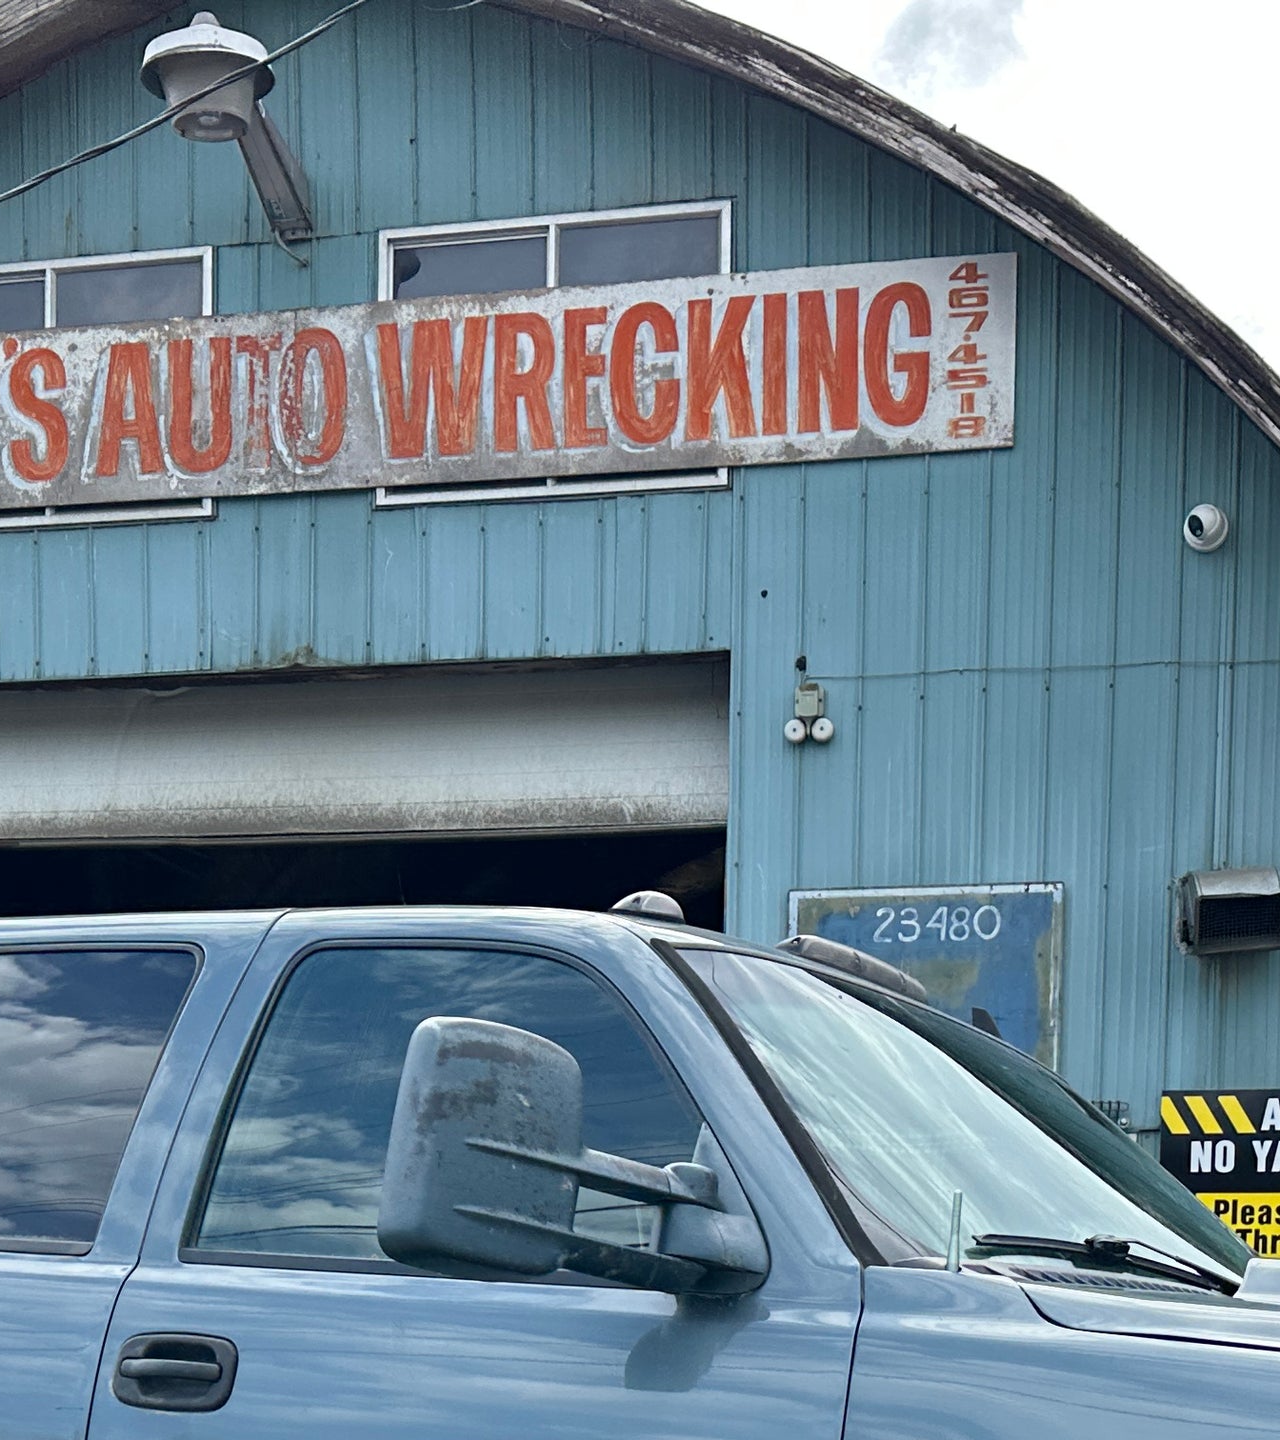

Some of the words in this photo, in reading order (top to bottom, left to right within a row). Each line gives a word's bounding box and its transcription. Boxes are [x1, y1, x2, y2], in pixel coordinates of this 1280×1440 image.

[95, 327, 349, 477] AUTO
[376, 280, 933, 459] WRECKING
[872, 905, 1002, 944] 23480
[1189, 1140, 1235, 1173] NO
